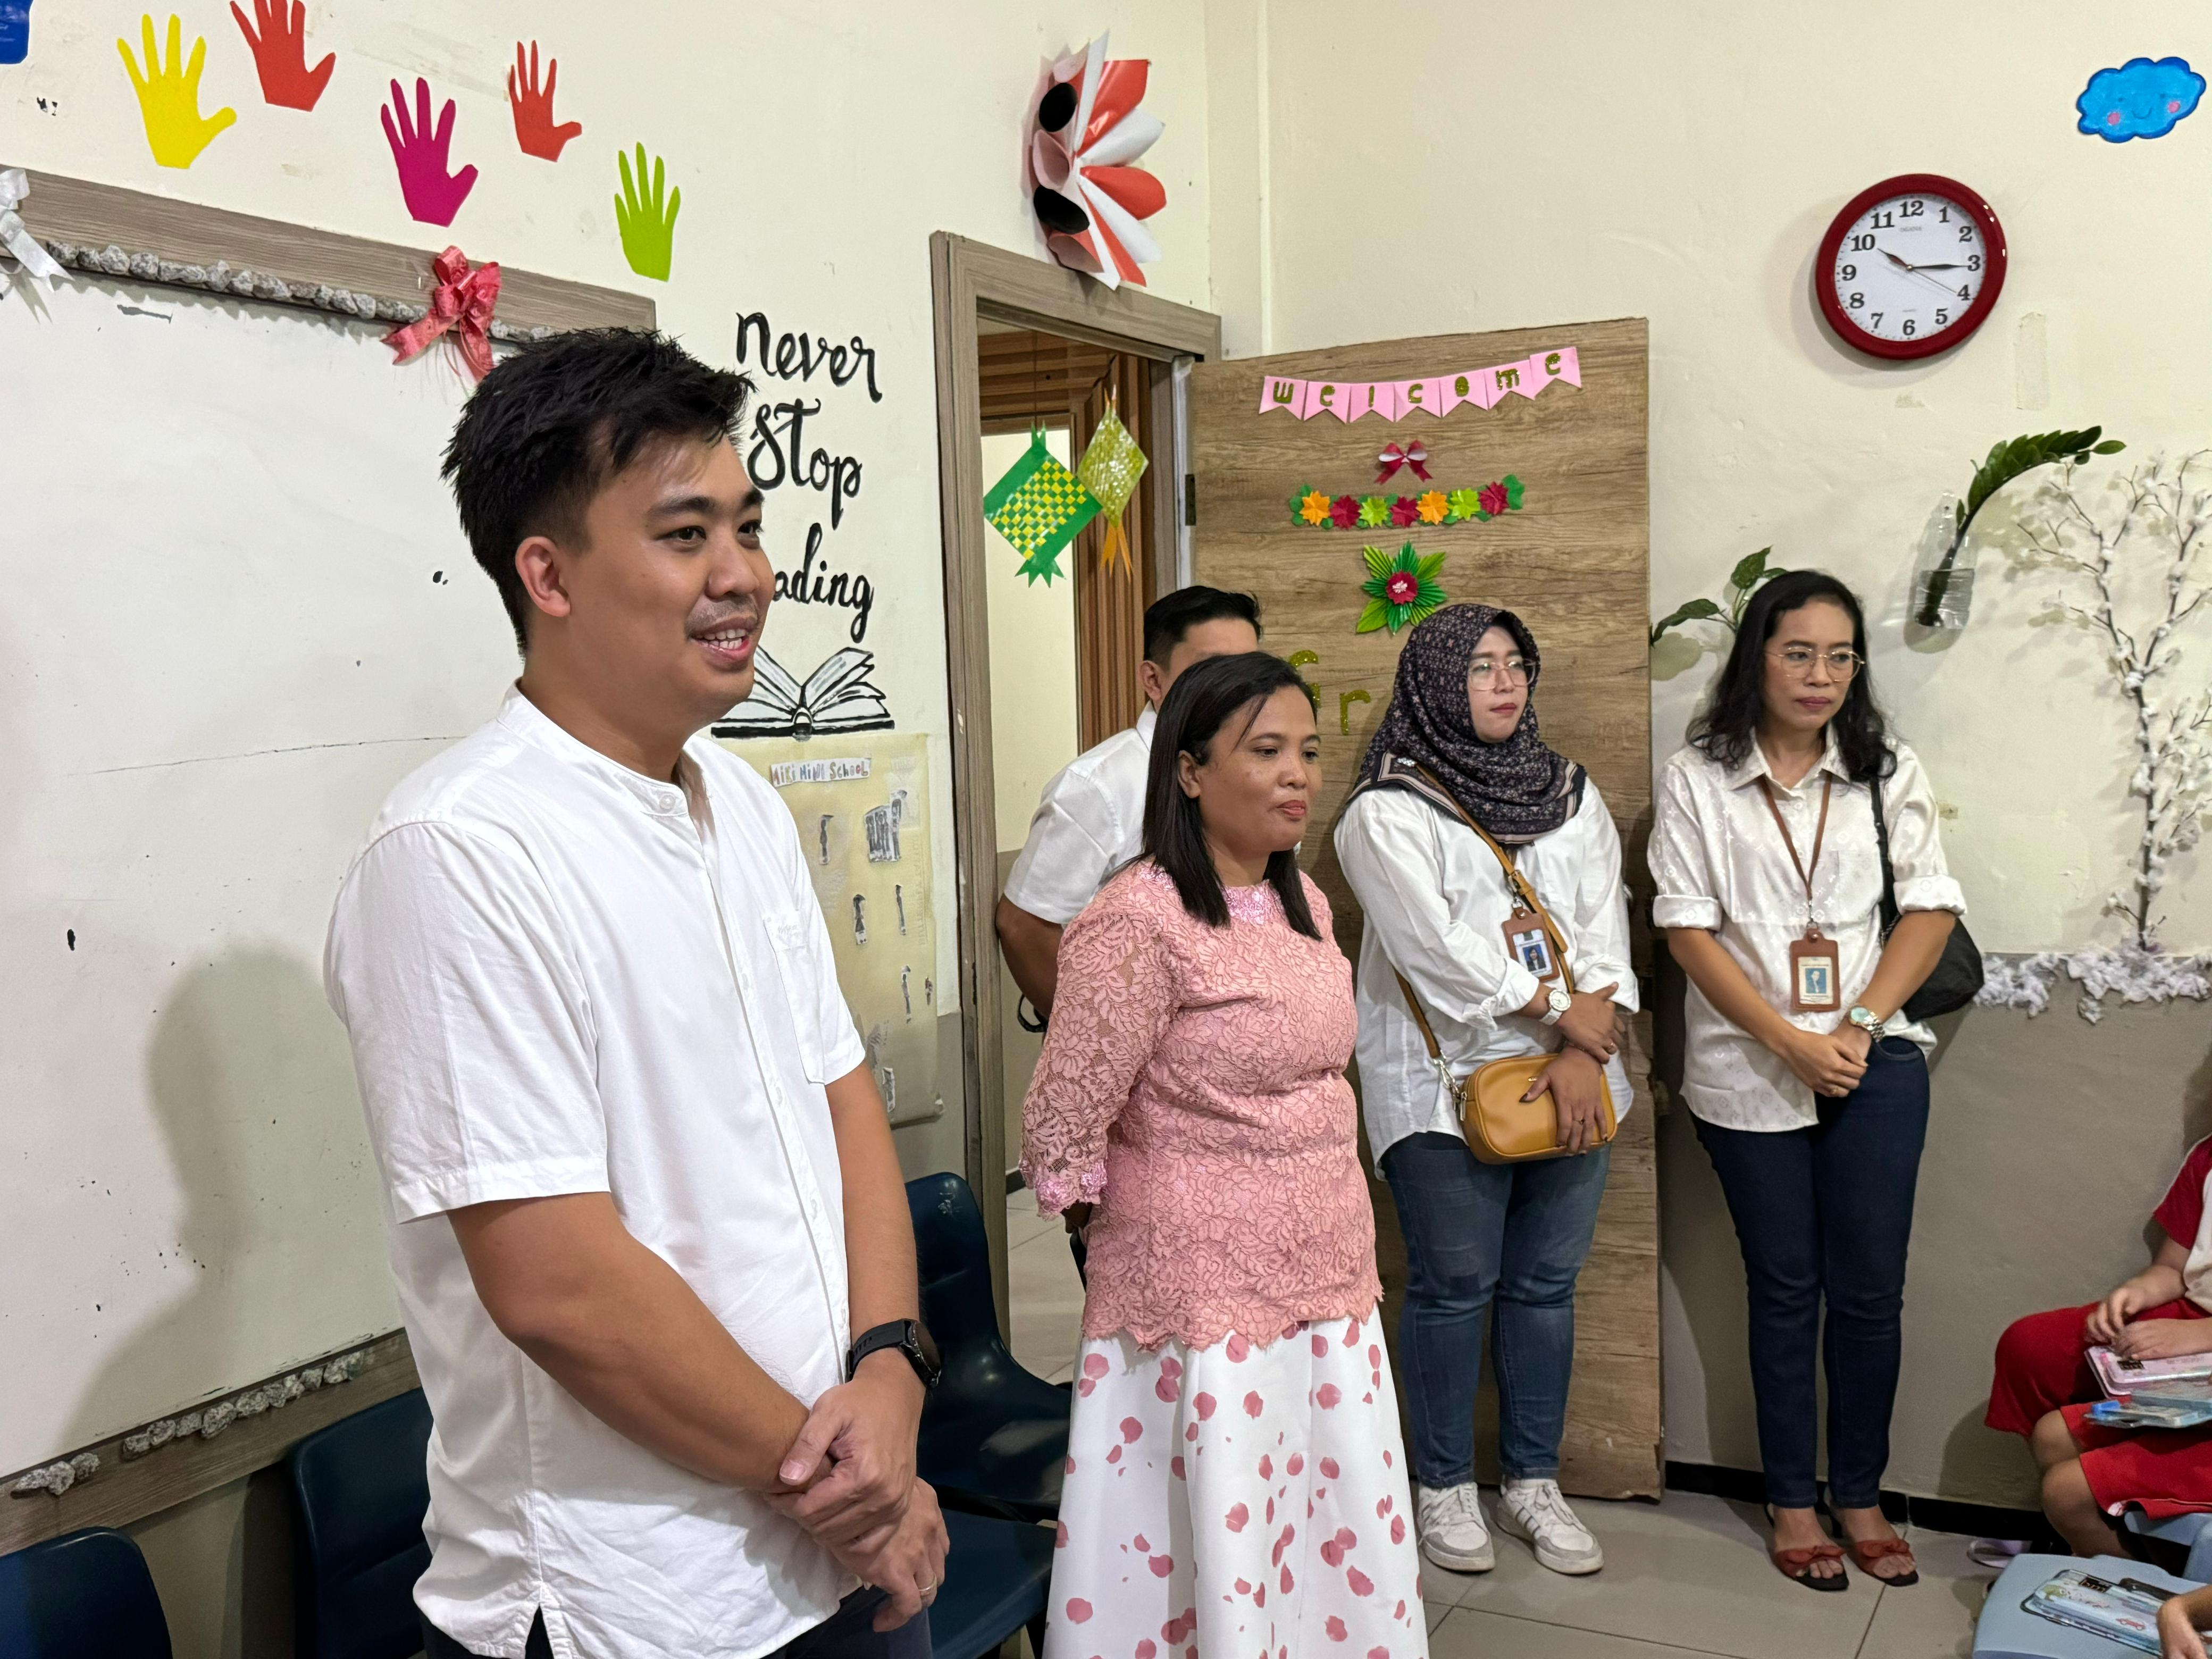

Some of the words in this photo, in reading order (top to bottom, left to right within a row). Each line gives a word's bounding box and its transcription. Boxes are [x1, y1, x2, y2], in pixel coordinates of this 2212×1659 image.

[1899, 200, 1924, 217] 12
[1939, 206, 1950, 223] 1
[1870, 212, 1895, 229] 11
[1959, 226, 1972, 242] 2
[1850, 234, 1875, 252] 10
[1967, 255, 1980, 271] 3
[1842, 264, 1857, 281] 9
[1849, 292, 1864, 308] 8
[1957, 284, 1971, 300] 4
[1871, 312, 1883, 329] 7
[1935, 308, 1948, 324] 5
[1903, 319, 1915, 336] 6
[1273, 353, 1562, 408] welcome
[772, 522, 875, 643] ading
